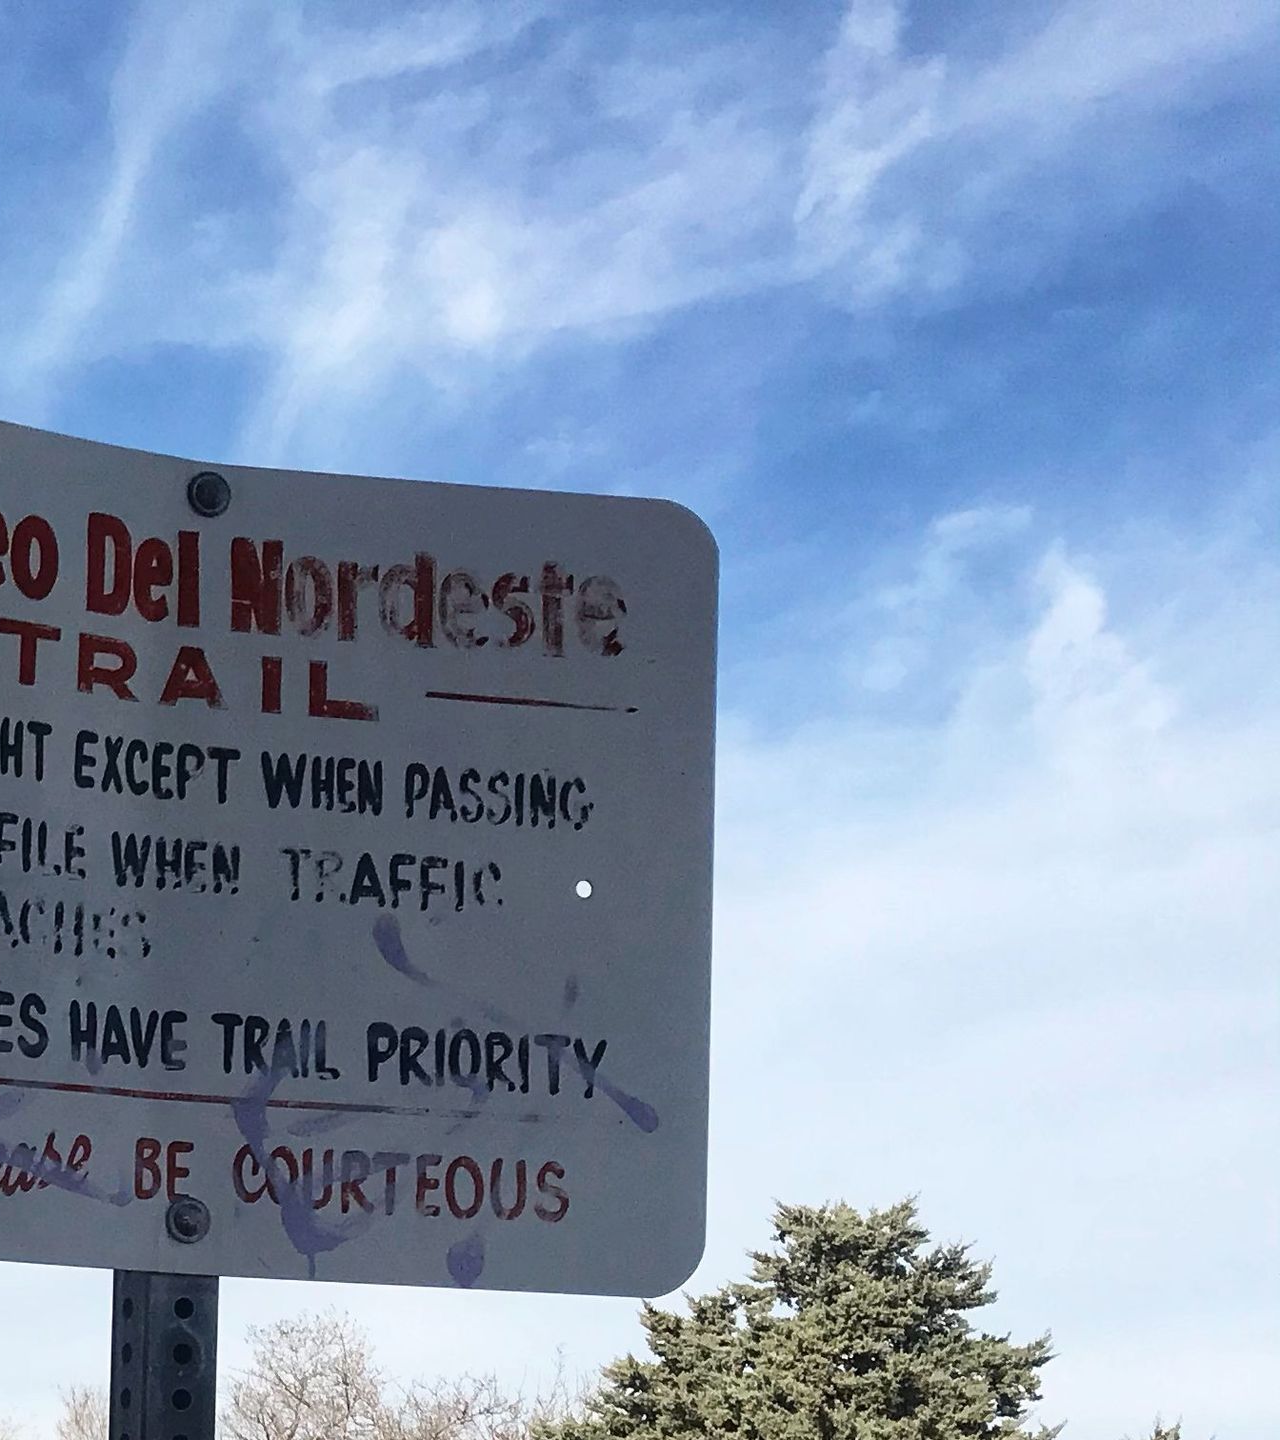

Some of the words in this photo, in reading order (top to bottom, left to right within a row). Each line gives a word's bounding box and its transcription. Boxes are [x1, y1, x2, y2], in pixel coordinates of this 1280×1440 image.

[85, 511, 201, 627] Del
[230, 536, 627, 657] Nordeste
[73, 729, 241, 804] EXCEPT
[260, 750, 384, 817] WHEN
[404, 761, 595, 831] PASSING
[111, 830, 242, 895] WHEN
[280, 847, 504, 913] TRAFFIC
[67, 998, 189, 1071] HAVE
[210, 1012, 341, 1081] TRAIL
[365, 1020, 608, 1099] PRIORITY
[133, 1136, 195, 1201] BE
[231, 1141, 571, 1223] COURTEOUS
